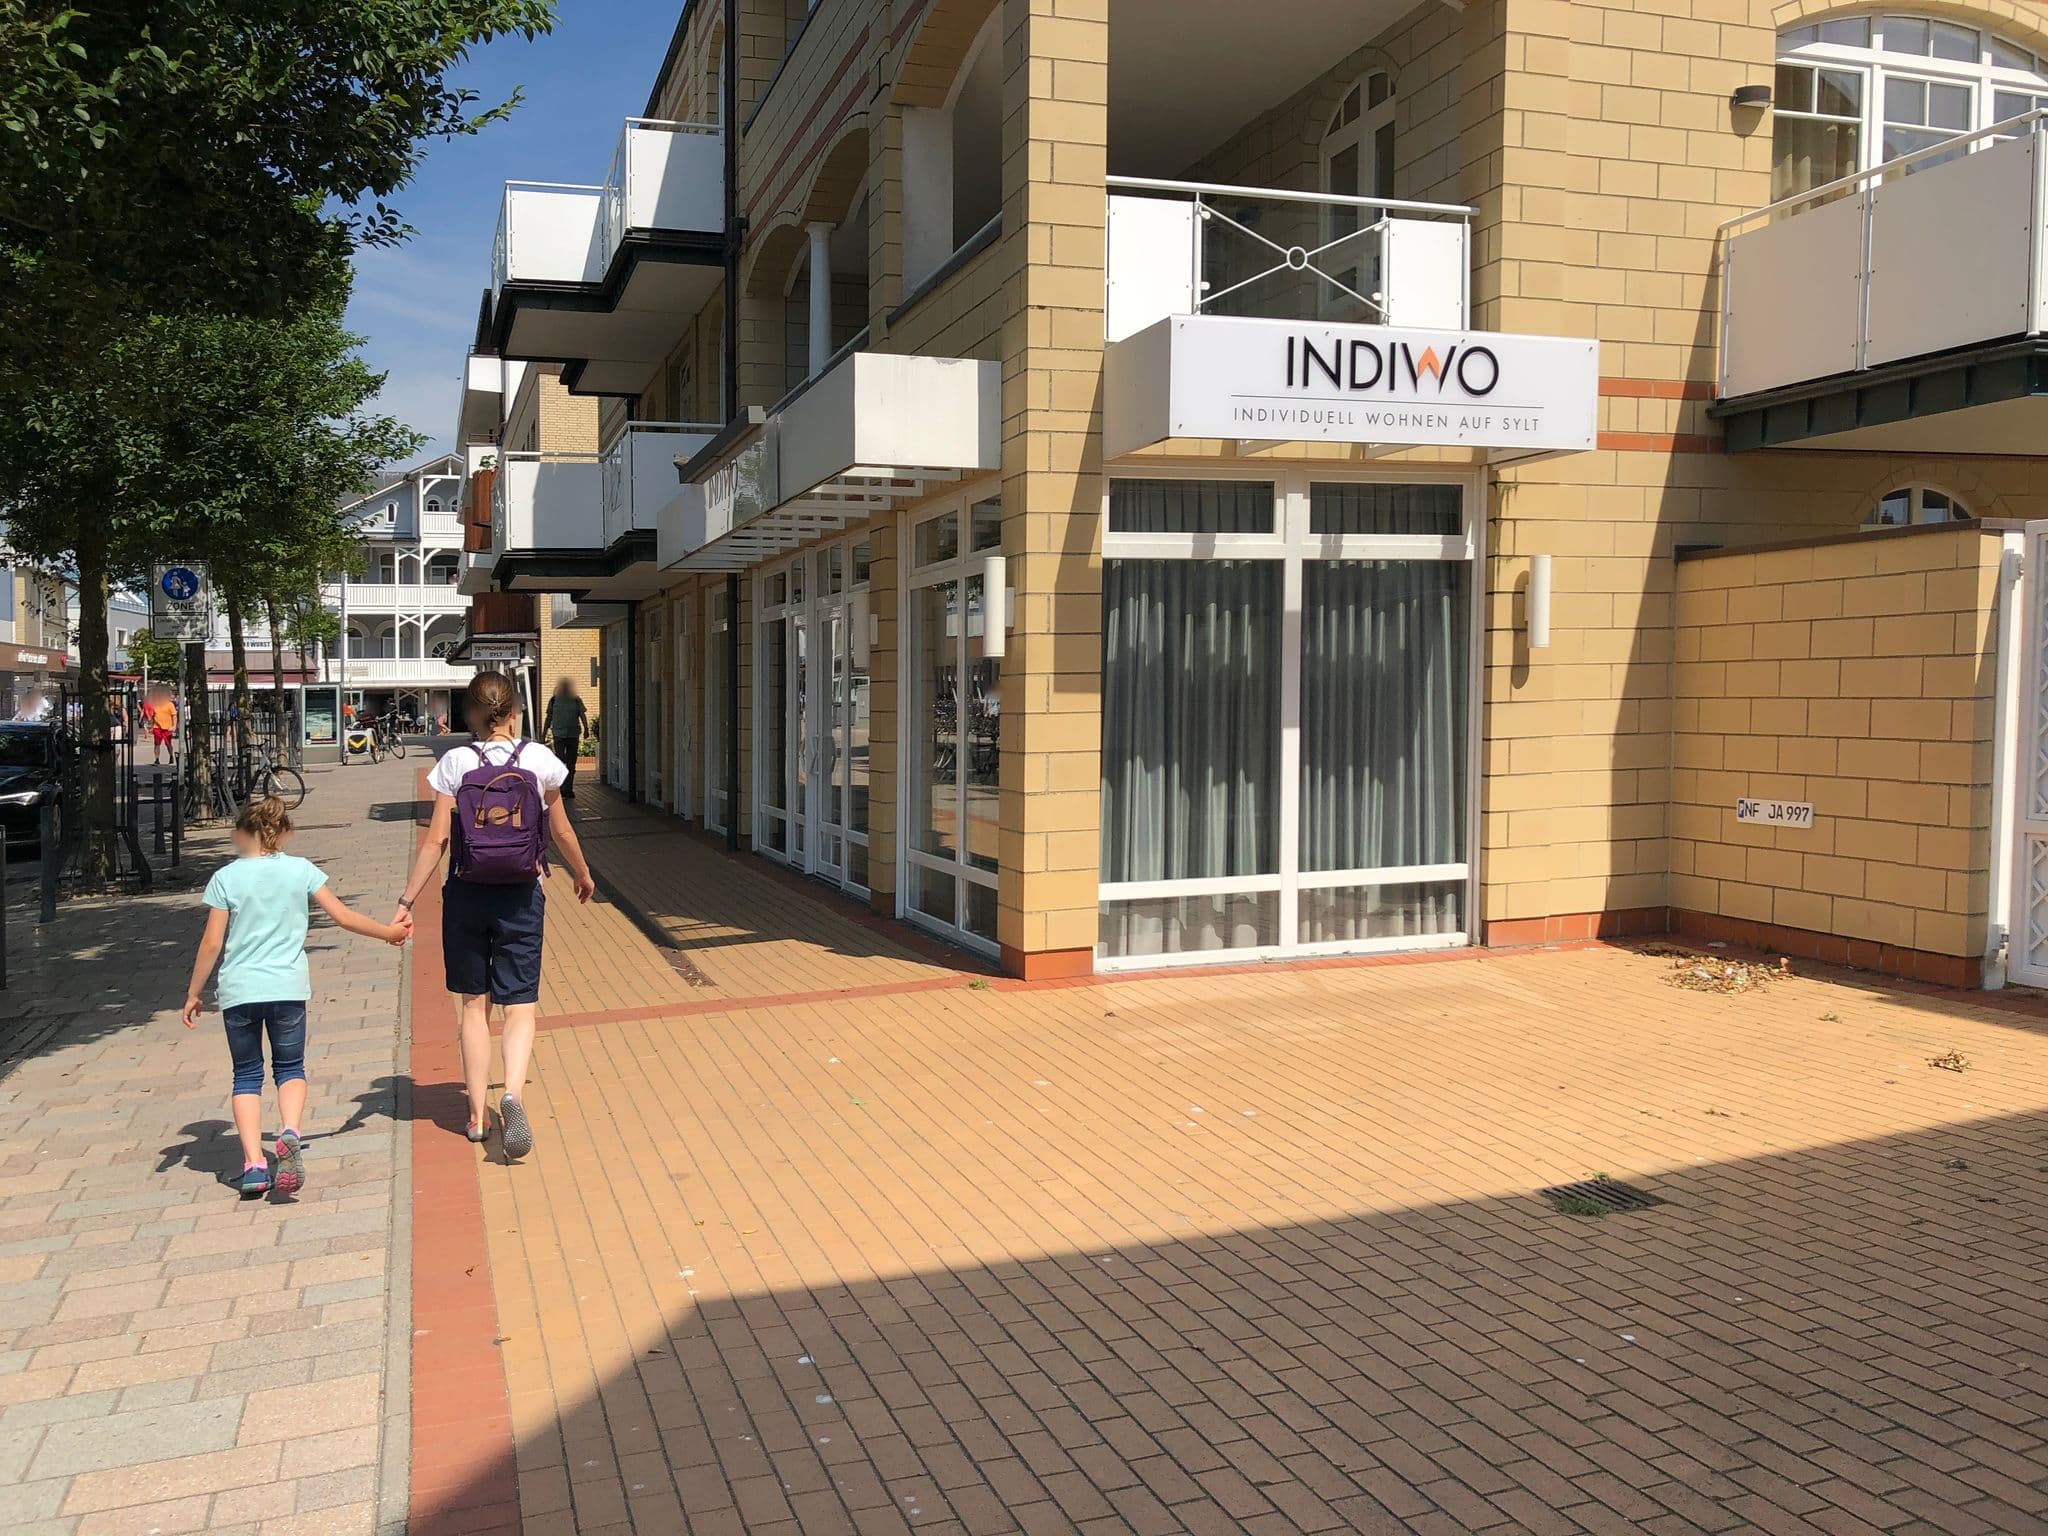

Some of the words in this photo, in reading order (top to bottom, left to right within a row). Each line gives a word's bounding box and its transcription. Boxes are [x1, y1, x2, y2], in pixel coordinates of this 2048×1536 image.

[1286, 335, 1500, 397] INDIWO
[1233, 407, 1355, 426] INDIVIDUELL
[1365, 411, 1449, 429] WOHNEN
[1459, 414, 1492, 430] AUF
[1502, 416, 1540, 432] SYLT
[167, 601, 195, 611] ZONE
[1745, 803, 1760, 817] NF
[1768, 804, 1784, 820] JA
[1786, 806, 1810, 822] 997
